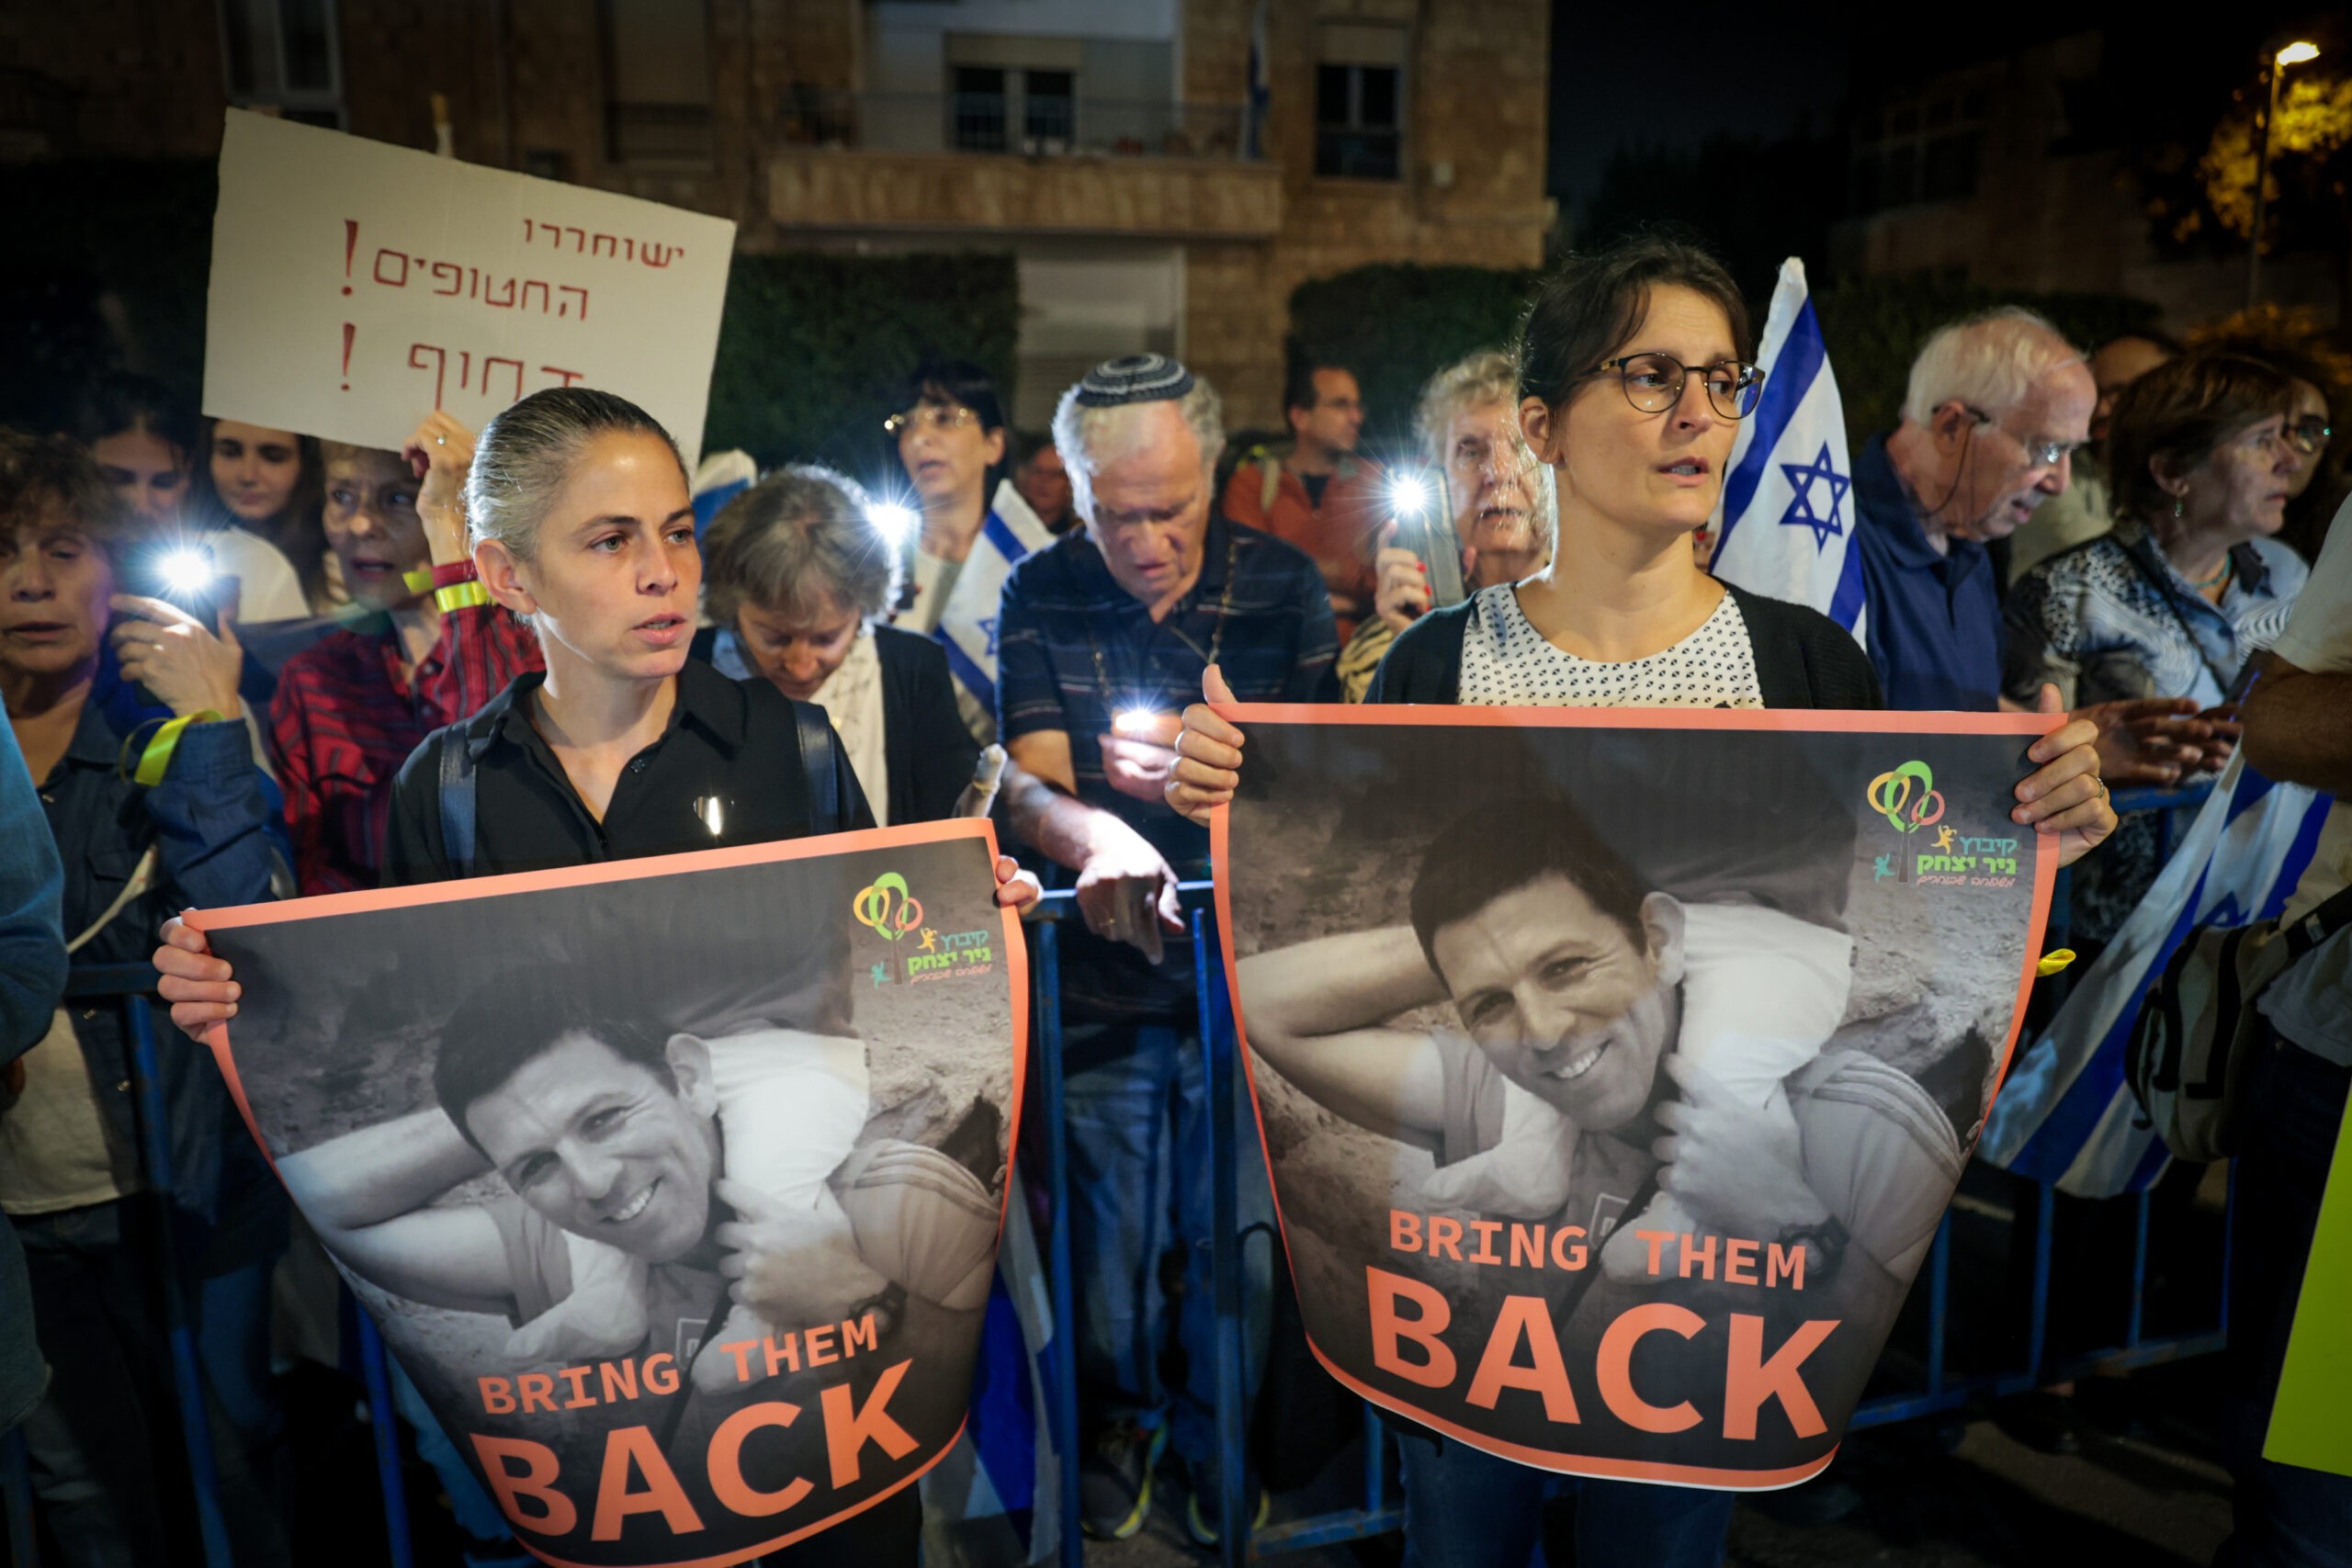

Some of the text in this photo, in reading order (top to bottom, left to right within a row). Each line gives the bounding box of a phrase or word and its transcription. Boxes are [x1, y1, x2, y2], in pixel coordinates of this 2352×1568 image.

[523, 218, 684, 268] ישוחררו
[1917, 854, 2018, 875] ניר יצחק
[1959, 836, 2018, 856] קיבוץ
[907, 947, 991, 976] ניר יצחק
[941, 930, 989, 951] קיבוץ
[1389, 1208, 1806, 1291] BRING THEM
[477, 1313, 878, 1415] BRING THEM
[1365, 1264, 1842, 1440] BACK
[469, 1358, 921, 1541] BACK
